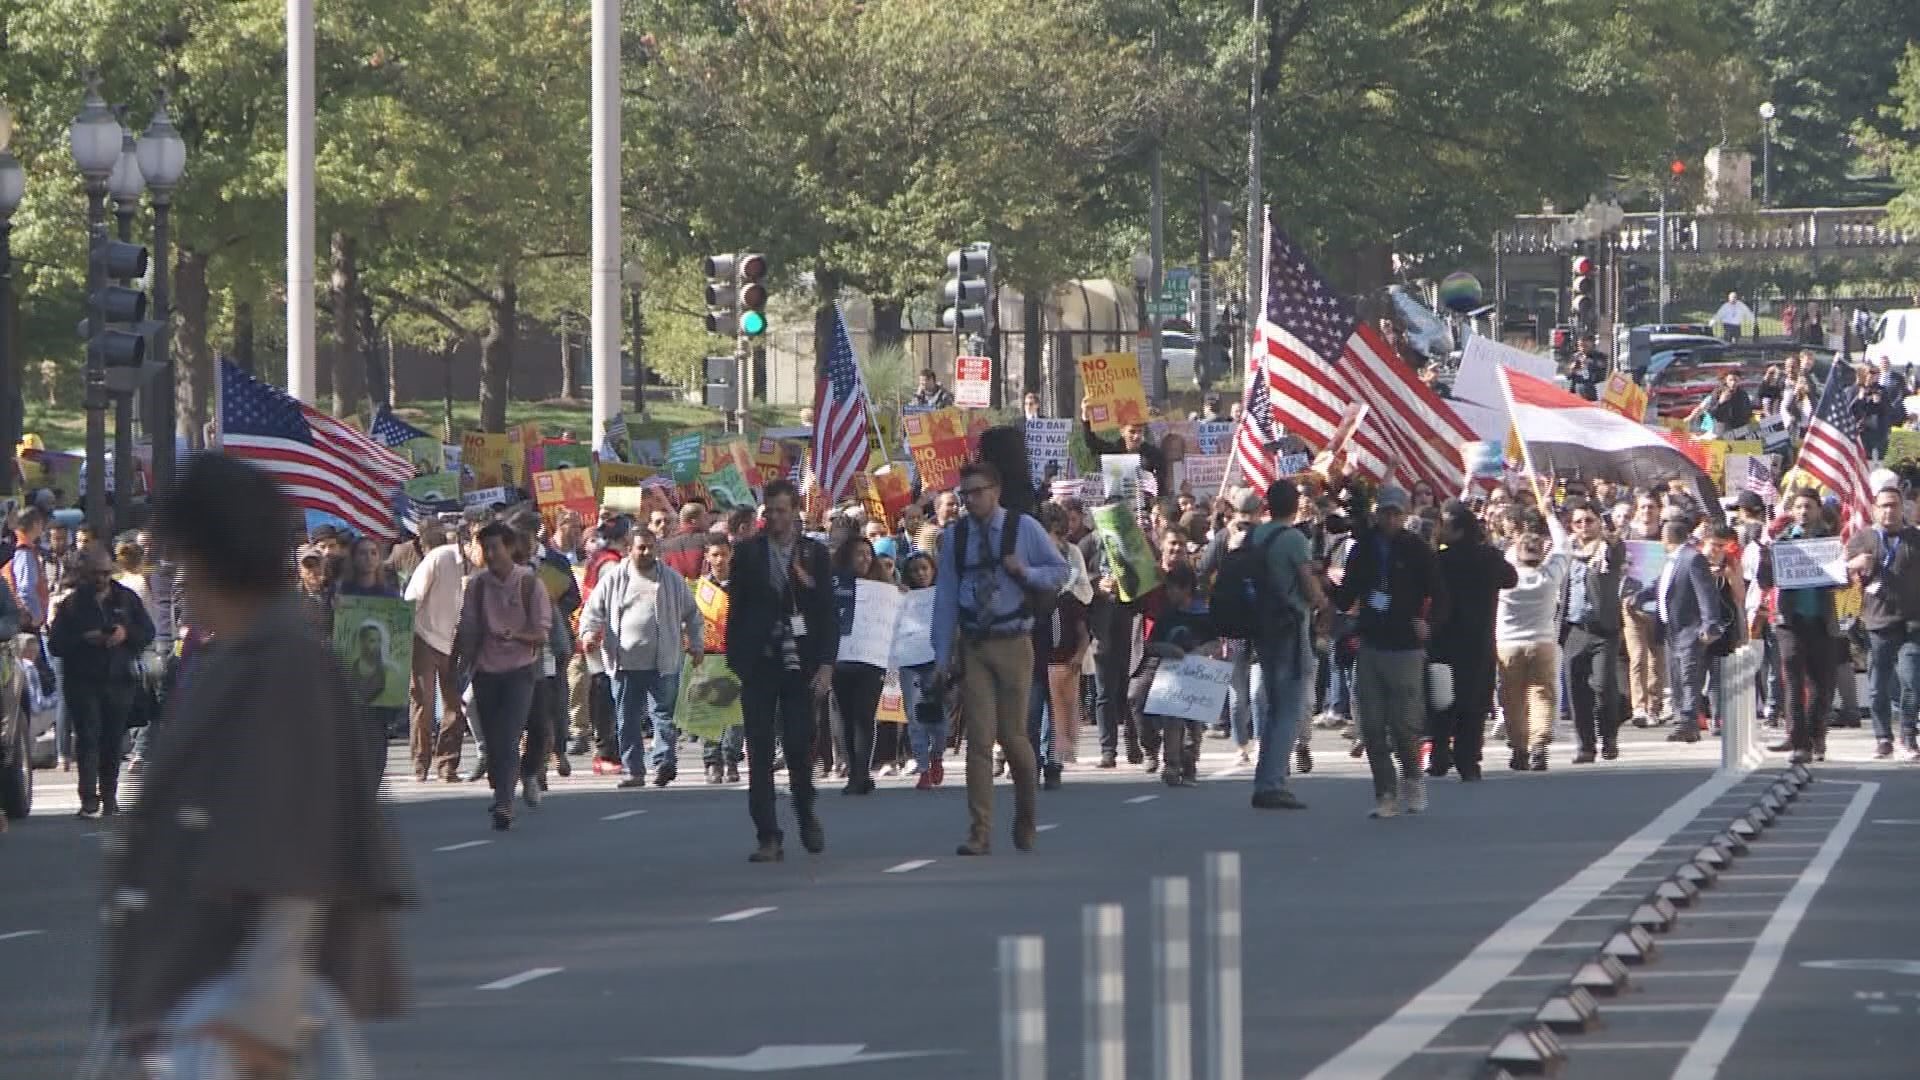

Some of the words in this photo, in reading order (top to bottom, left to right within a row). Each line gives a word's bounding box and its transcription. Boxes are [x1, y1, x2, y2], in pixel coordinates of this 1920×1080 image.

[1082, 359, 1107, 372] NO
[1085, 367, 1138, 385] MUSLIM
[1087, 383, 1114, 398] BAN
[1027, 420, 1043, 429] NO
[1047, 421, 1066, 430] BAN
[1208, 424, 1229, 433] BAN
[464, 434, 485, 448] NO
[1027, 434, 1042, 443] NO
[913, 446, 936, 462] NO
[759, 464, 779, 480] NO
[916, 453, 968, 481] MUSLIM
[480, 489, 498, 499] BAN
